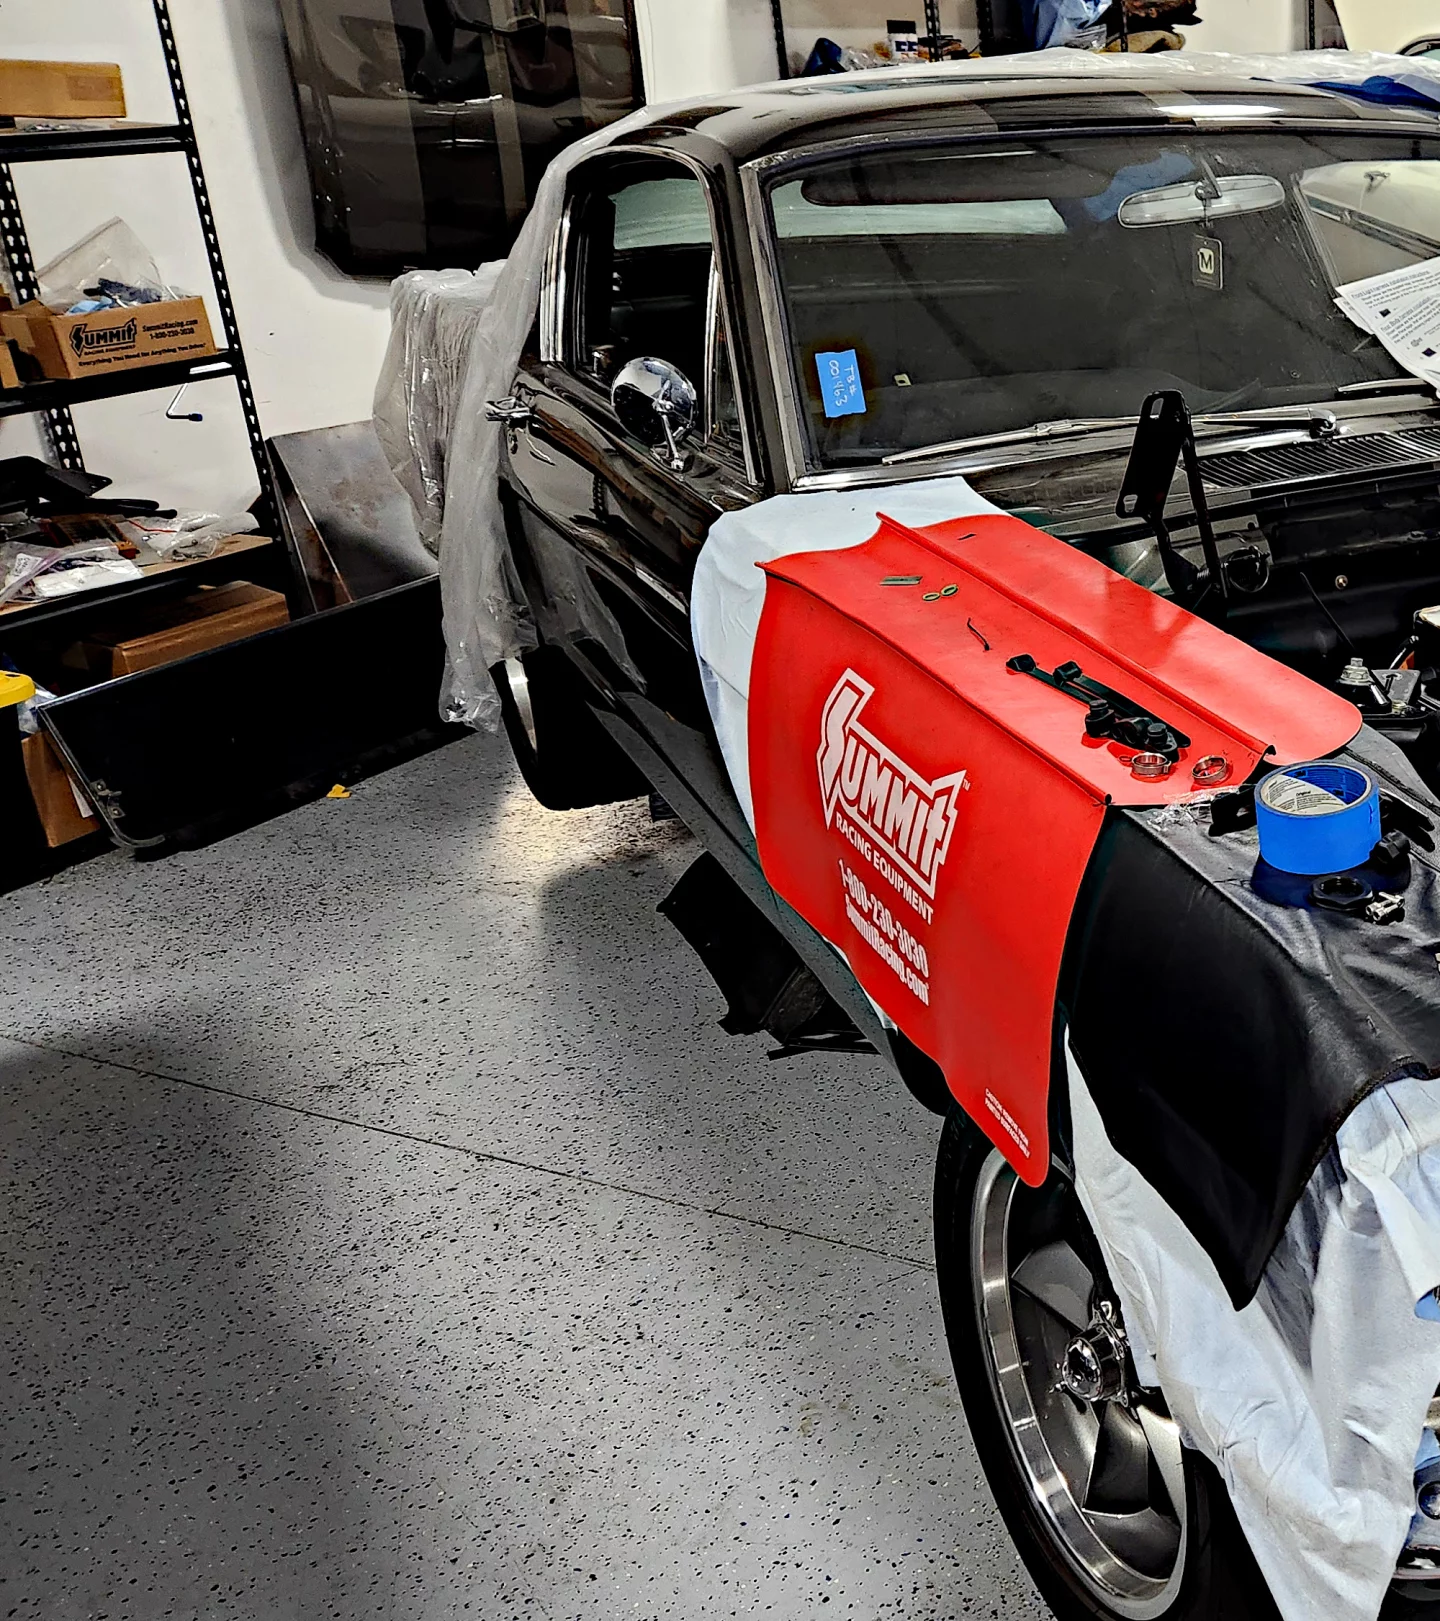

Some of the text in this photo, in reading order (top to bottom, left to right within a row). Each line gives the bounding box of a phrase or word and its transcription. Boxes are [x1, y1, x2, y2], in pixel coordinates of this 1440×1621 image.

[836, 811, 934, 926] RACING EQUIPMENT
[838, 858, 930, 978] 1-800-230-3030
